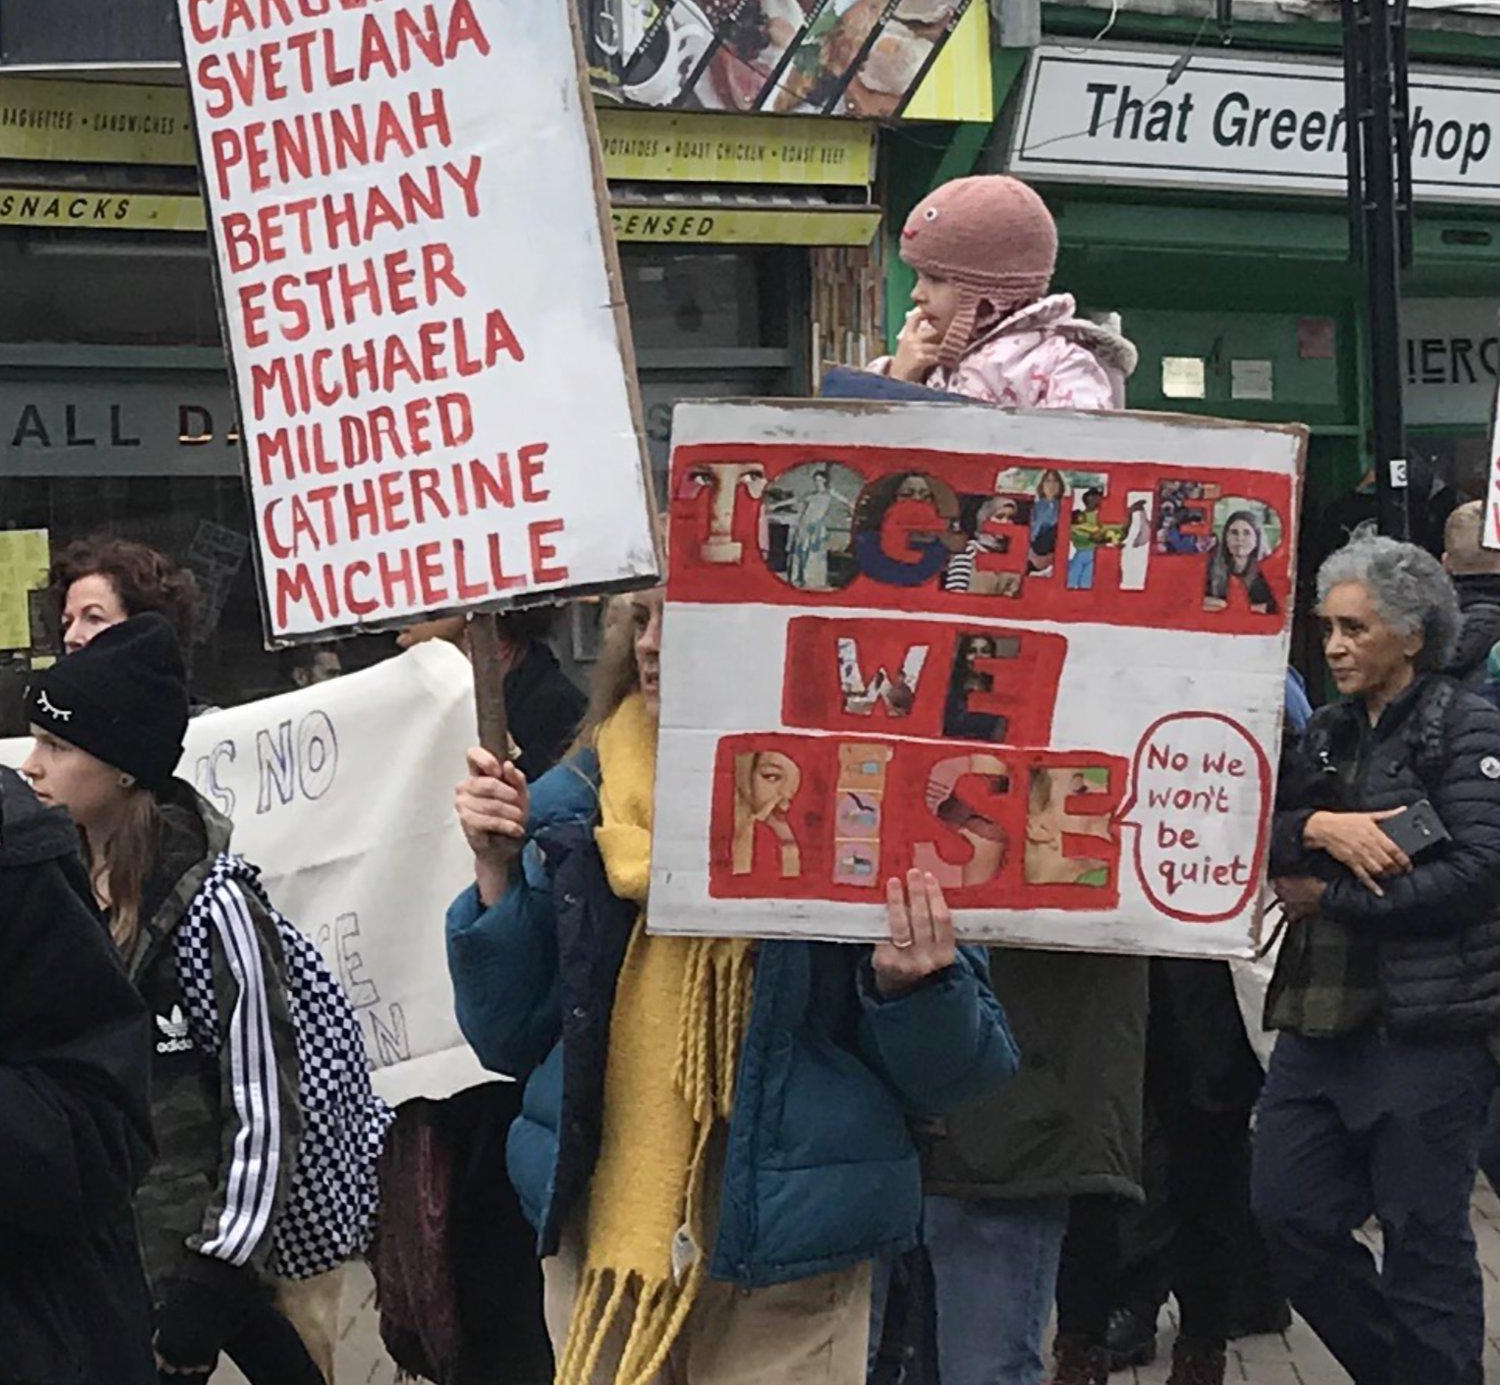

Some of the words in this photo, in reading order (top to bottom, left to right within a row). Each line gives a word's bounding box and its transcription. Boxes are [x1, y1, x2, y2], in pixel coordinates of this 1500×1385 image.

[211, 88, 452, 201] PENINAH
[1084, 82, 1195, 145] That
[0, 195, 131, 220] SNACKS
[221, 155, 483, 274] BETHANY
[238, 242, 467, 348] ESTHER
[251, 309, 525, 421] MICHAELA
[12, 404, 141, 447] ALL
[256, 392, 475, 486] MILDRED
[263, 442, 550, 559] CATHERINE
[677, 461, 1285, 615] TOGETHER
[275, 517, 569, 630] MICHELLE
[836, 633, 1022, 742] WE
[255, 710, 338, 815] NO
[1147, 743, 1189, 772] No
[732, 742, 1114, 891] RISE
[1157, 821, 1200, 849] be
[1158, 854, 1250, 895] quiet
